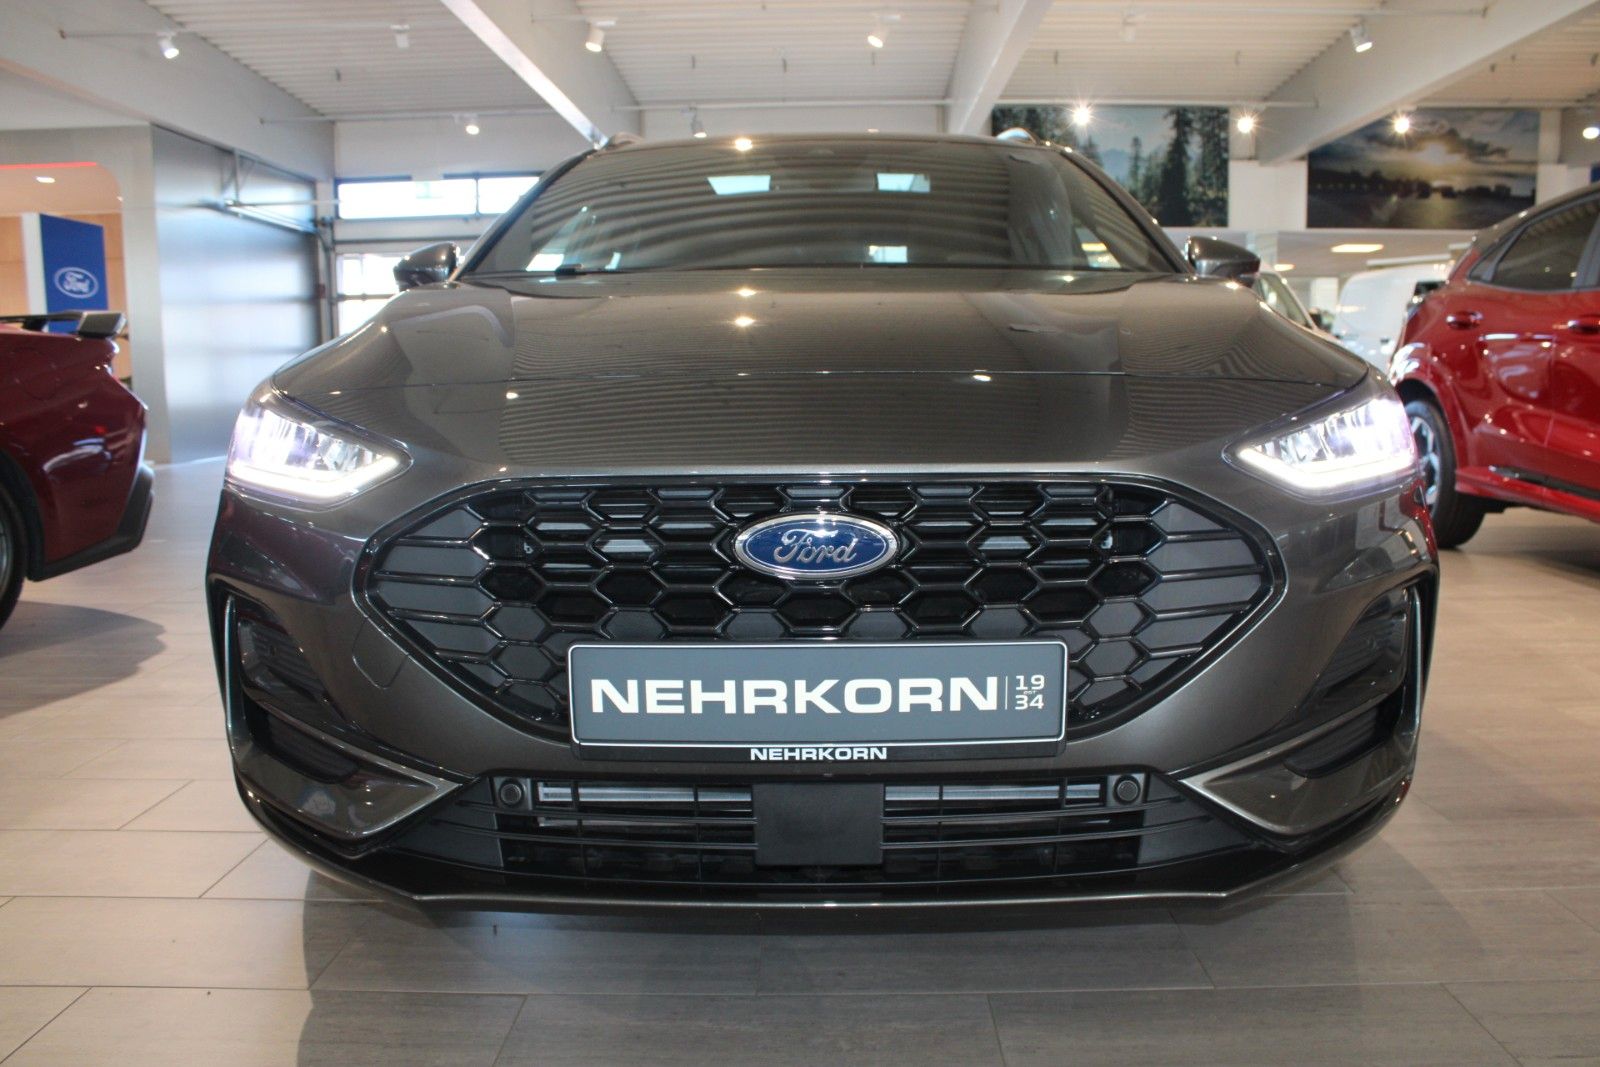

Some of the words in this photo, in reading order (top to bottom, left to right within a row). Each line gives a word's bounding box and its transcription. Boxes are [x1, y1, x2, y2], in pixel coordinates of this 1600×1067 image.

[773, 528, 859, 563] Ford
[1015, 674, 1045, 690] 19
[591, 676, 998, 714] NEHRKORN
[1015, 694, 1044, 710] 34
[750, 747, 887, 761] NEHRKORN
